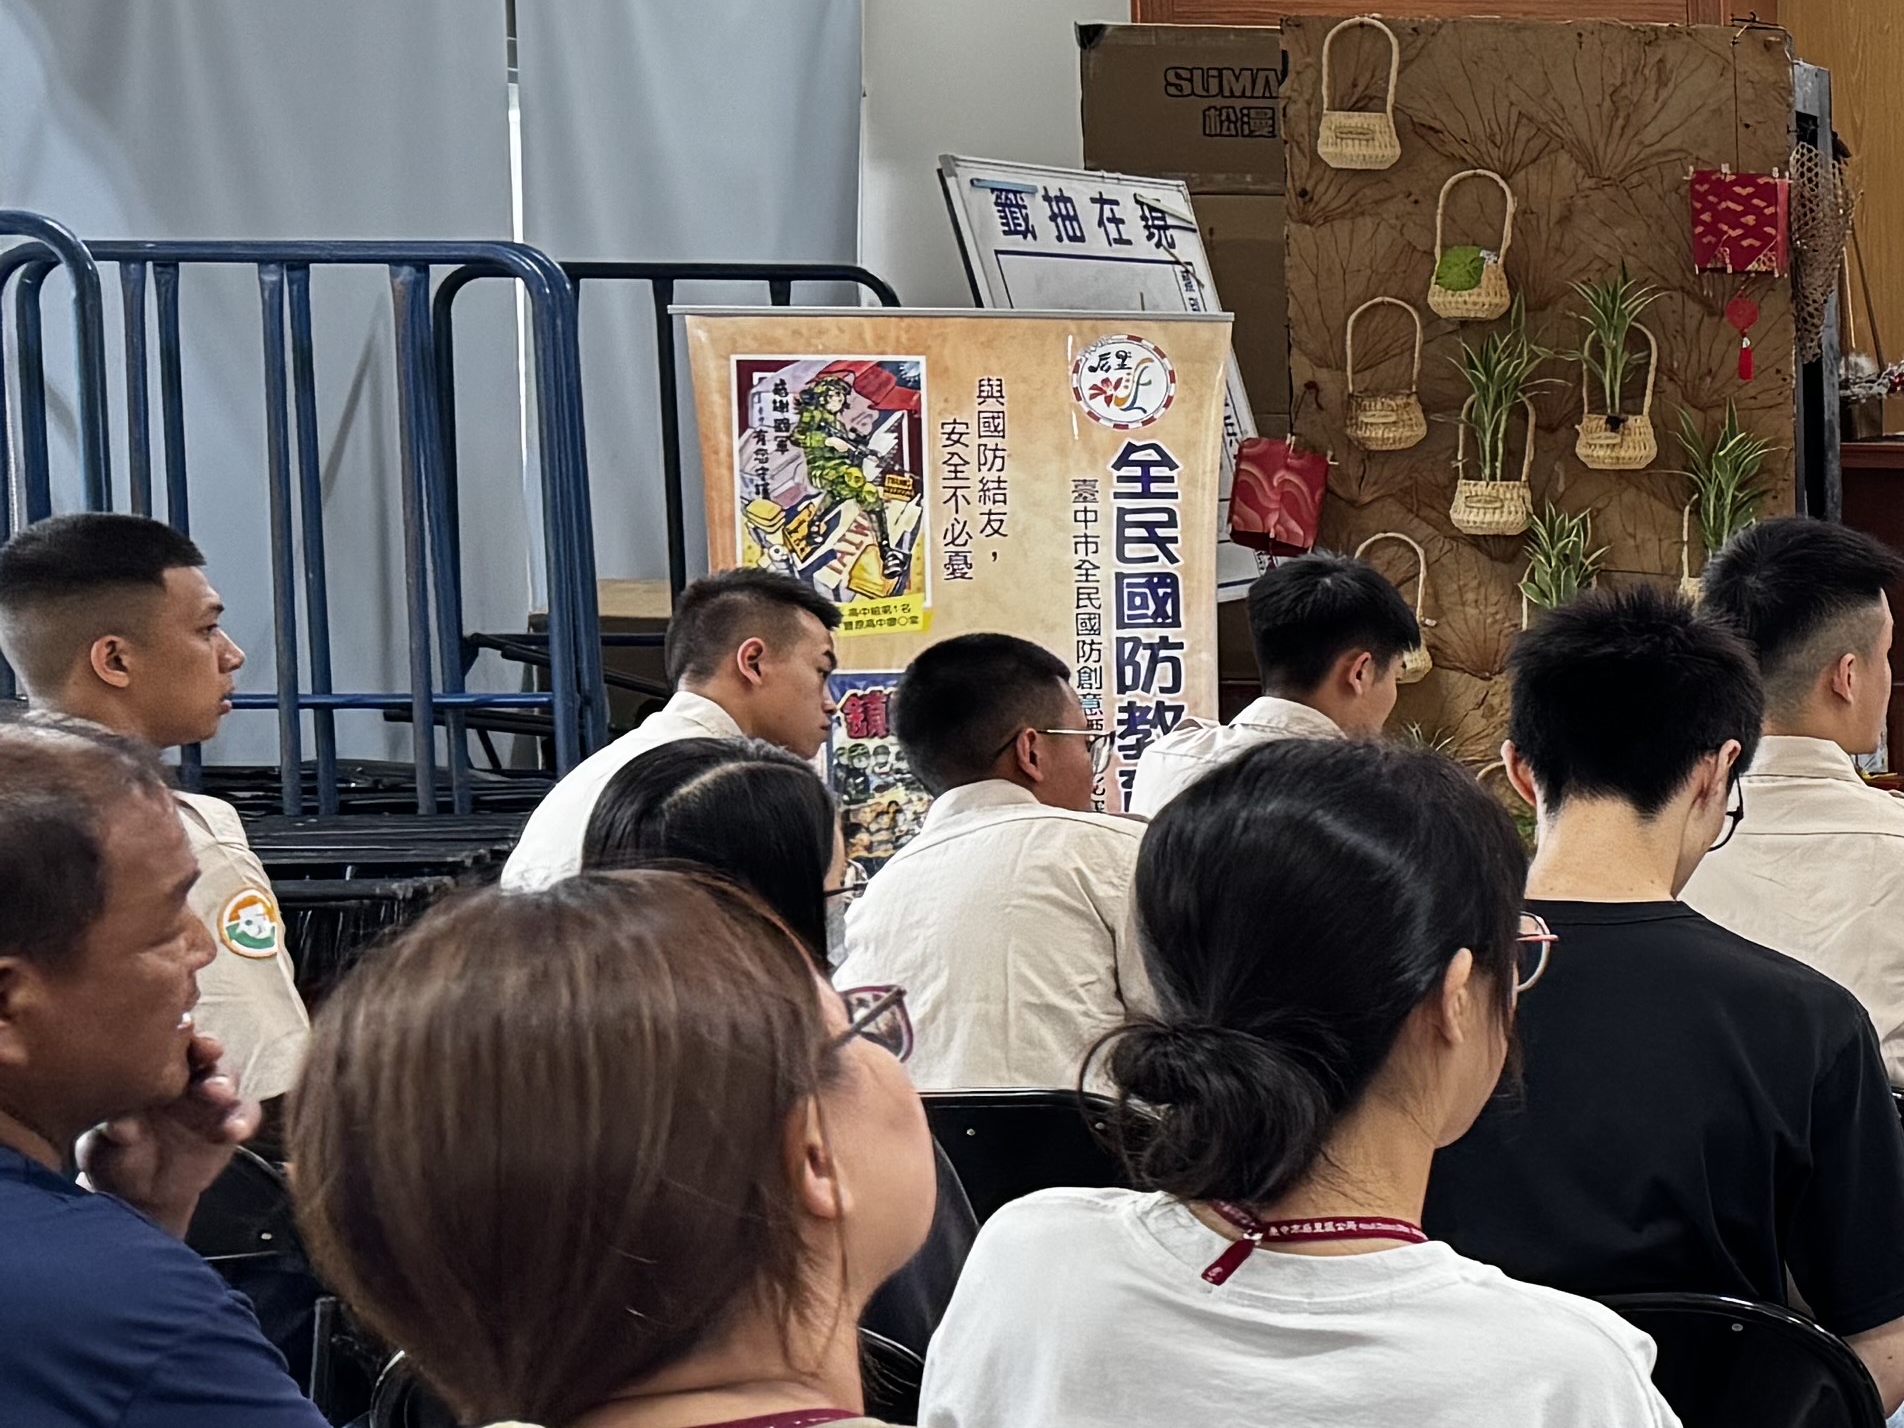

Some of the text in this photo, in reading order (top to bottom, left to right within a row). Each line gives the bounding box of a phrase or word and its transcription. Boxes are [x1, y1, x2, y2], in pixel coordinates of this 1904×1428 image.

[1163, 66, 1279, 98] SUMA
[941, 418, 974, 581] 安全不必憂
[1112, 440, 1186, 813] 全民國防教
